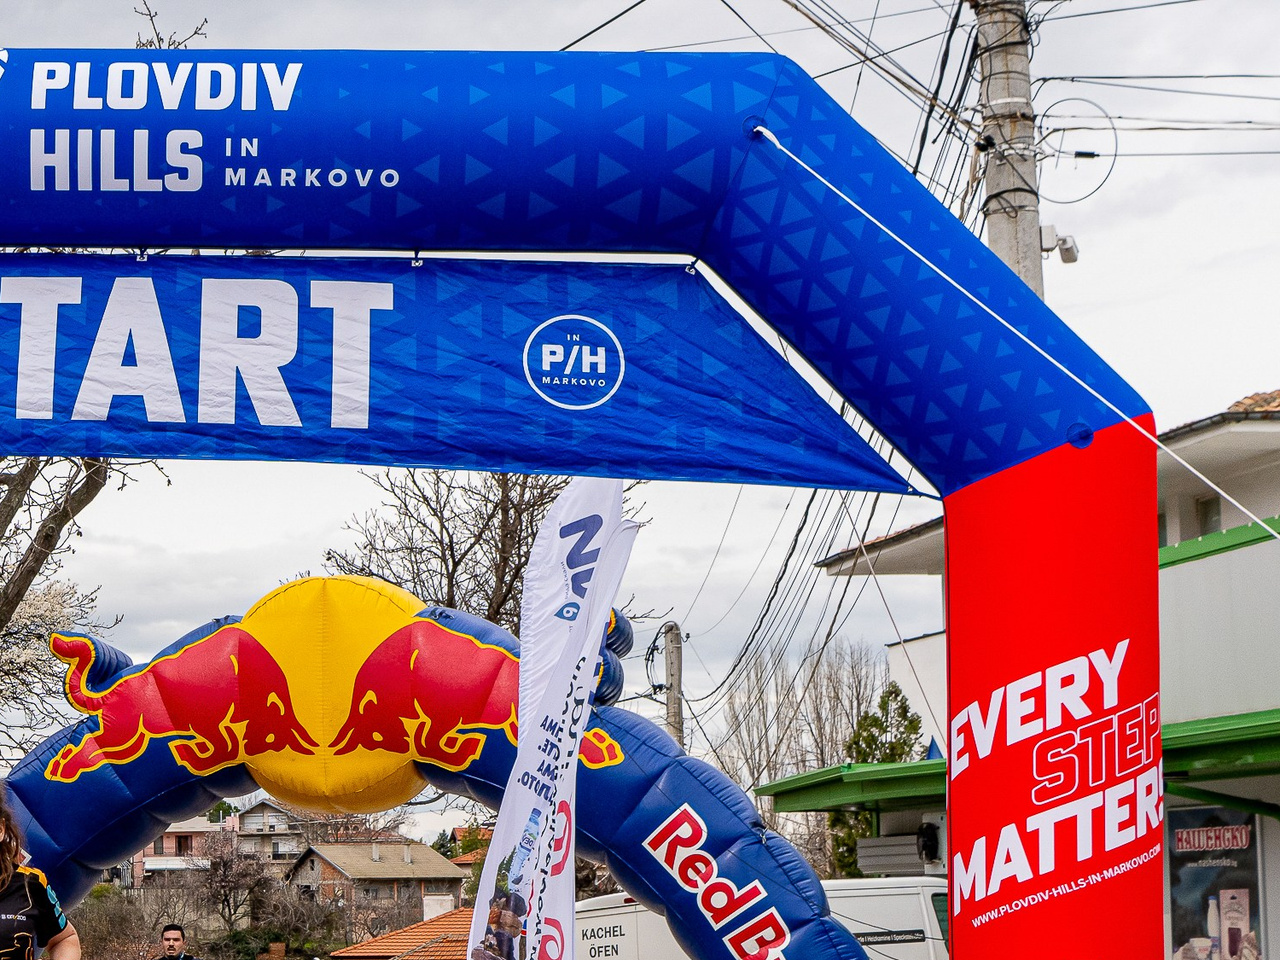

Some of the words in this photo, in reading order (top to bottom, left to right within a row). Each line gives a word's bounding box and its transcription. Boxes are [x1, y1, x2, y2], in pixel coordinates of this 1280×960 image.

[30, 61, 303, 111] PLOVDIV
[30, 128, 203, 192] HILLS
[225, 138, 259, 157] IN
[225, 168, 400, 187] MARKOVO
[566, 333, 580, 342] IN
[541, 343, 606, 375] P/H
[542, 376, 606, 387] MARKOVO
[951, 638, 1130, 781] EVERY
[1032, 691, 1161, 806] STEP
[1175, 825, 1252, 852] НАШЕНСКО
[644, 804, 766, 930] Red
[971, 842, 1162, 928] WWW.PLOVDIV-HILLS-IN-MARKOVO.COM
[581, 924, 626, 941] KACHEL
[589, 943, 619, 959] ÖFEN
